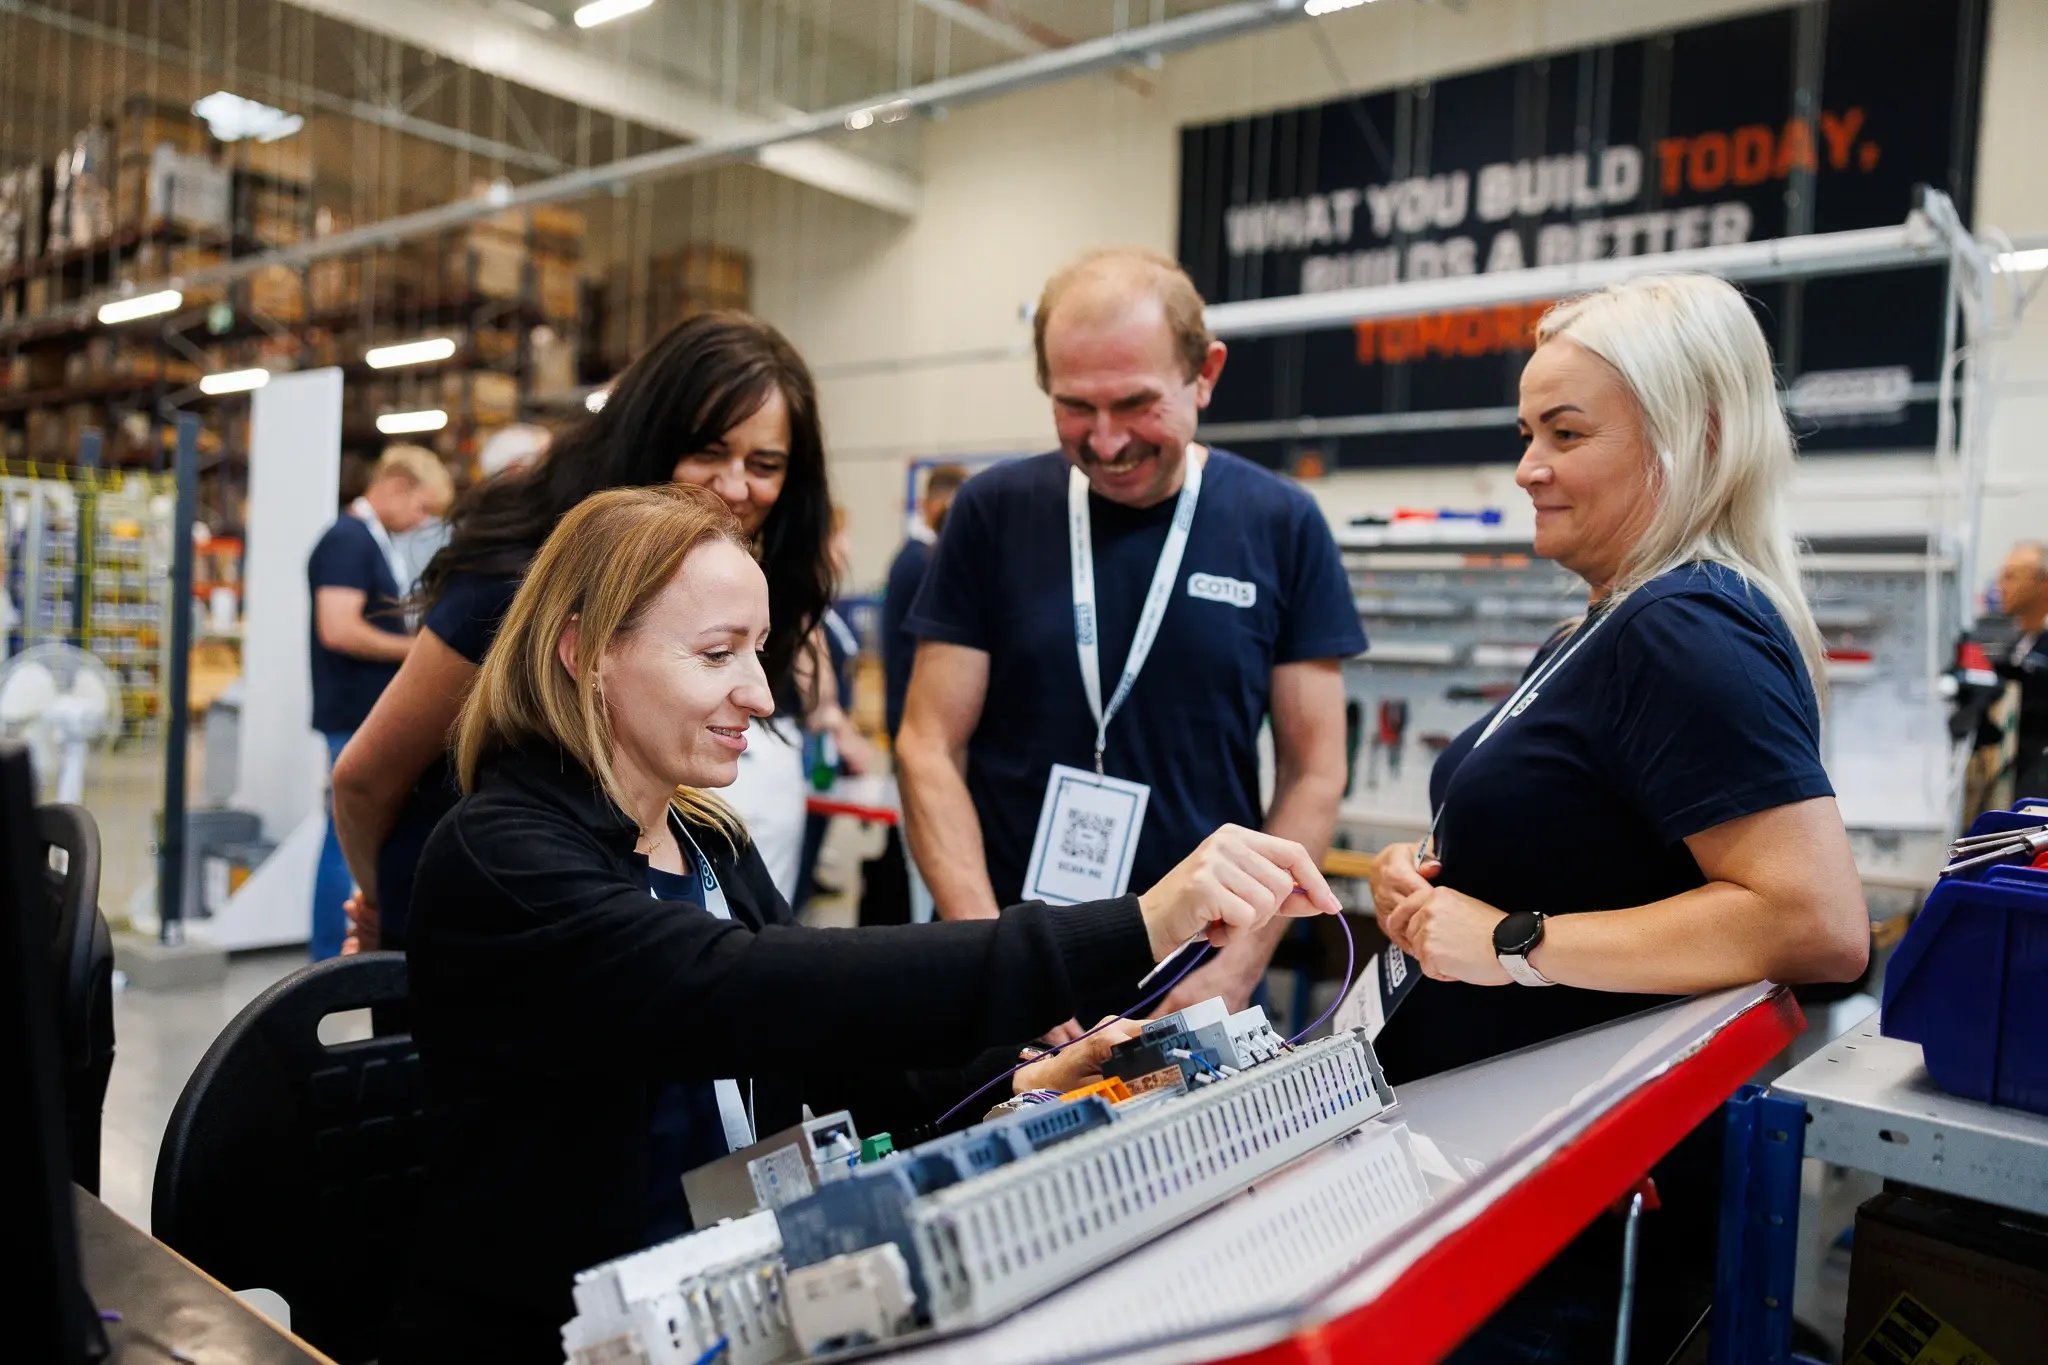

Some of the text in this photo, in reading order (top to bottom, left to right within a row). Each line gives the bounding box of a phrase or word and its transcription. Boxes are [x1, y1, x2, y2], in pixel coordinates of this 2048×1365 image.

[1226, 188, 1360, 256] WHAT
[1366, 175, 1469, 237] YOU
[1477, 145, 1642, 221] BUILD
[1301, 202, 1753, 294] BUILDS A BETTER
[1356, 301, 1548, 367] TOMOR
